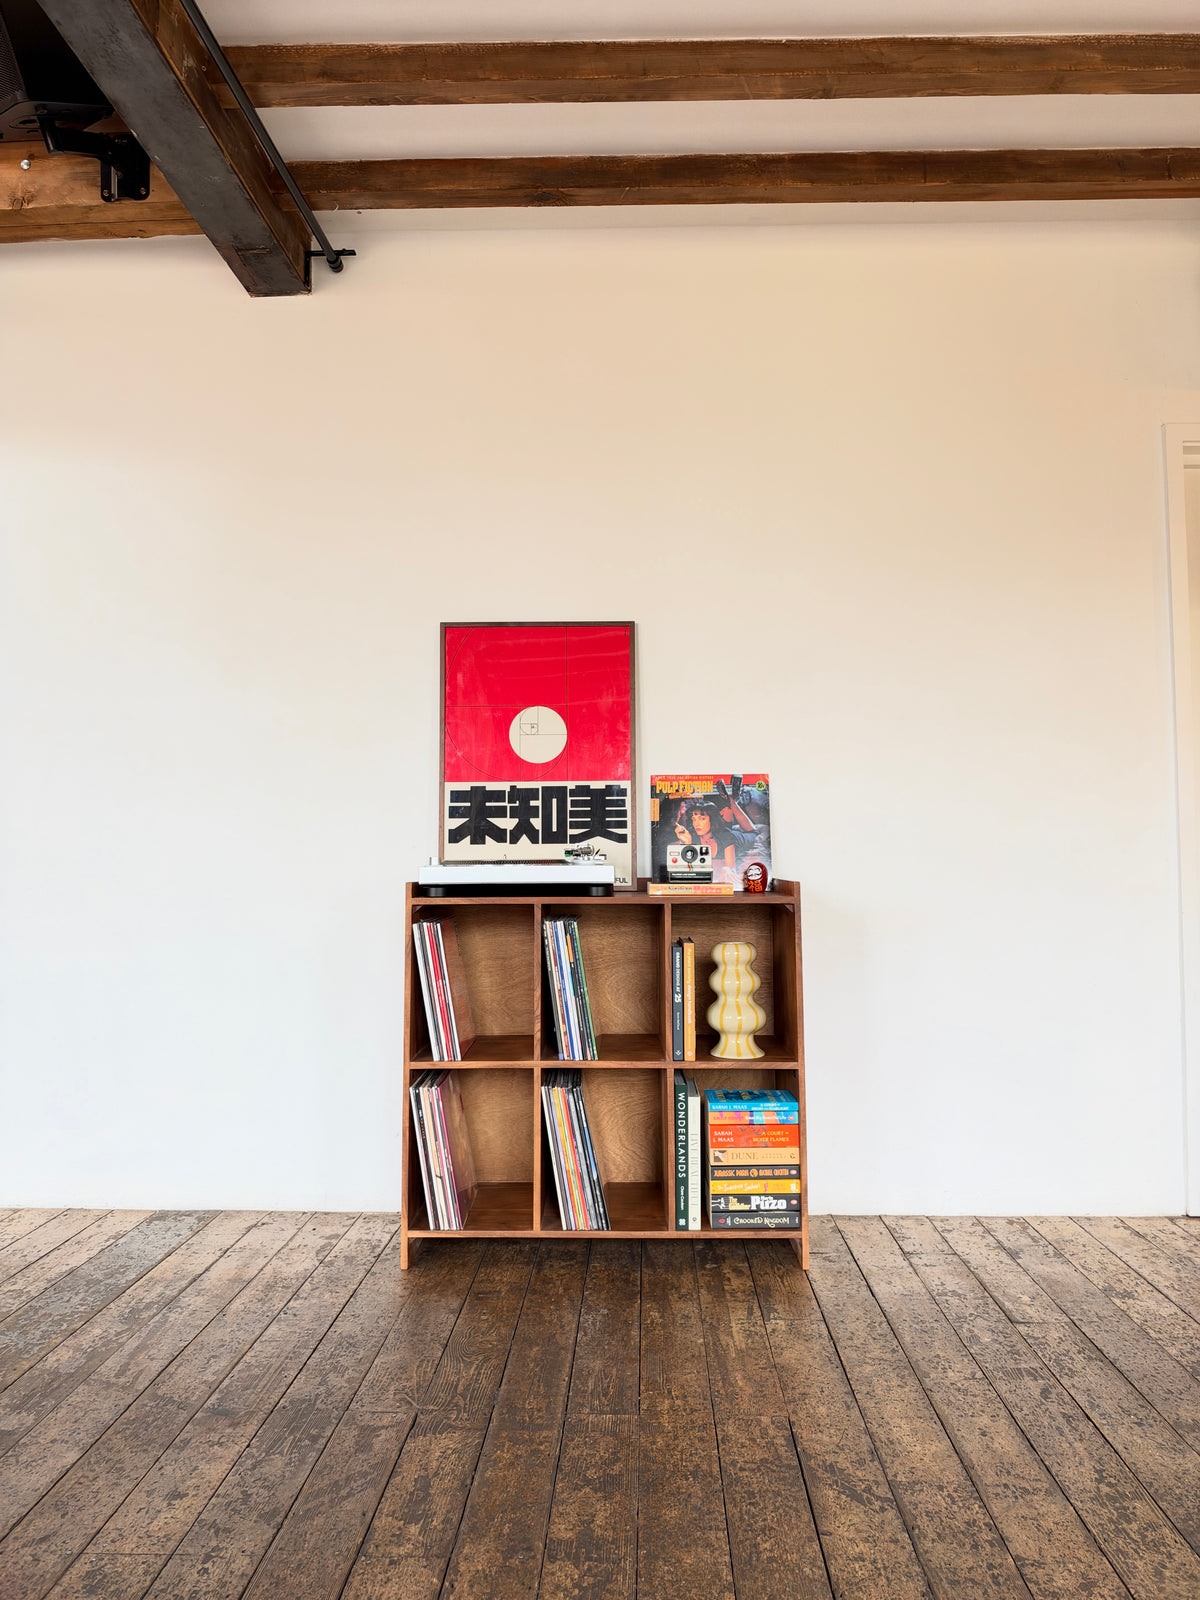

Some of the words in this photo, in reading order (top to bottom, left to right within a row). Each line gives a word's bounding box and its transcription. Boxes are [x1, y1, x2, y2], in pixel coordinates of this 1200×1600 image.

[656, 781, 678, 793] PULP
[680, 781, 713, 793] FICTION
[448, 785, 627, 845] 未知美
[674, 993, 682, 1003] 25
[678, 1092, 686, 1178] WONDERLANDS
[731, 1152, 758, 1160] DUNE
[750, 1195, 787, 1210] Puzo
[733, 1216, 763, 1225] CROOKED
[764, 1217, 790, 1228] KINGDOM
